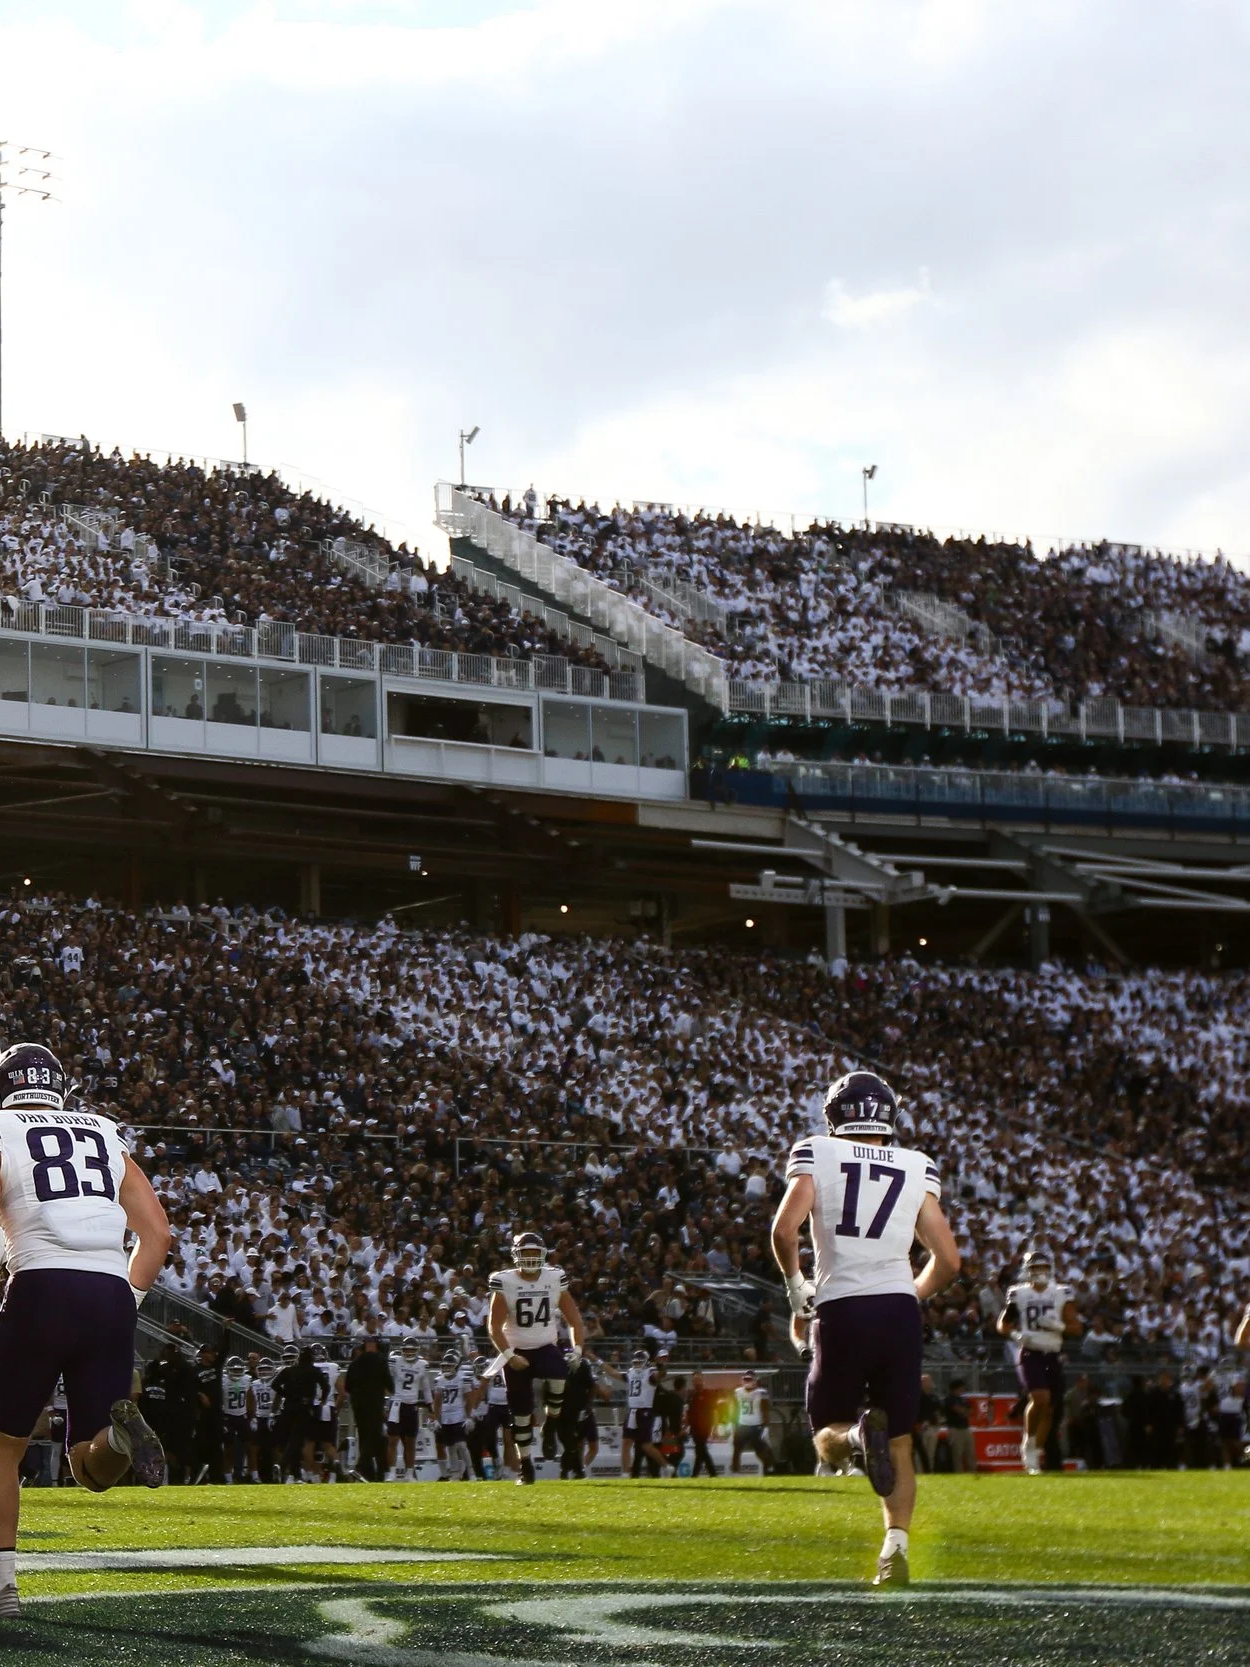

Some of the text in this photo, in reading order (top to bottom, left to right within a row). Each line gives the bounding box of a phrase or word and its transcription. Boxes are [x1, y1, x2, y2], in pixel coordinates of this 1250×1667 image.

[27, 1066, 51, 1085] 83
[14, 1113, 49, 1124] VAN
[858, 1101, 879, 1118] 17
[853, 1146, 894, 1162] WILDE
[26, 1126, 115, 1202] 83
[836, 1163, 905, 1239] 17
[516, 1297, 551, 1328] 64
[402, 1373, 414, 1391] 2
[629, 1379, 642, 1397] 13
[228, 1391, 245, 1409] 20
